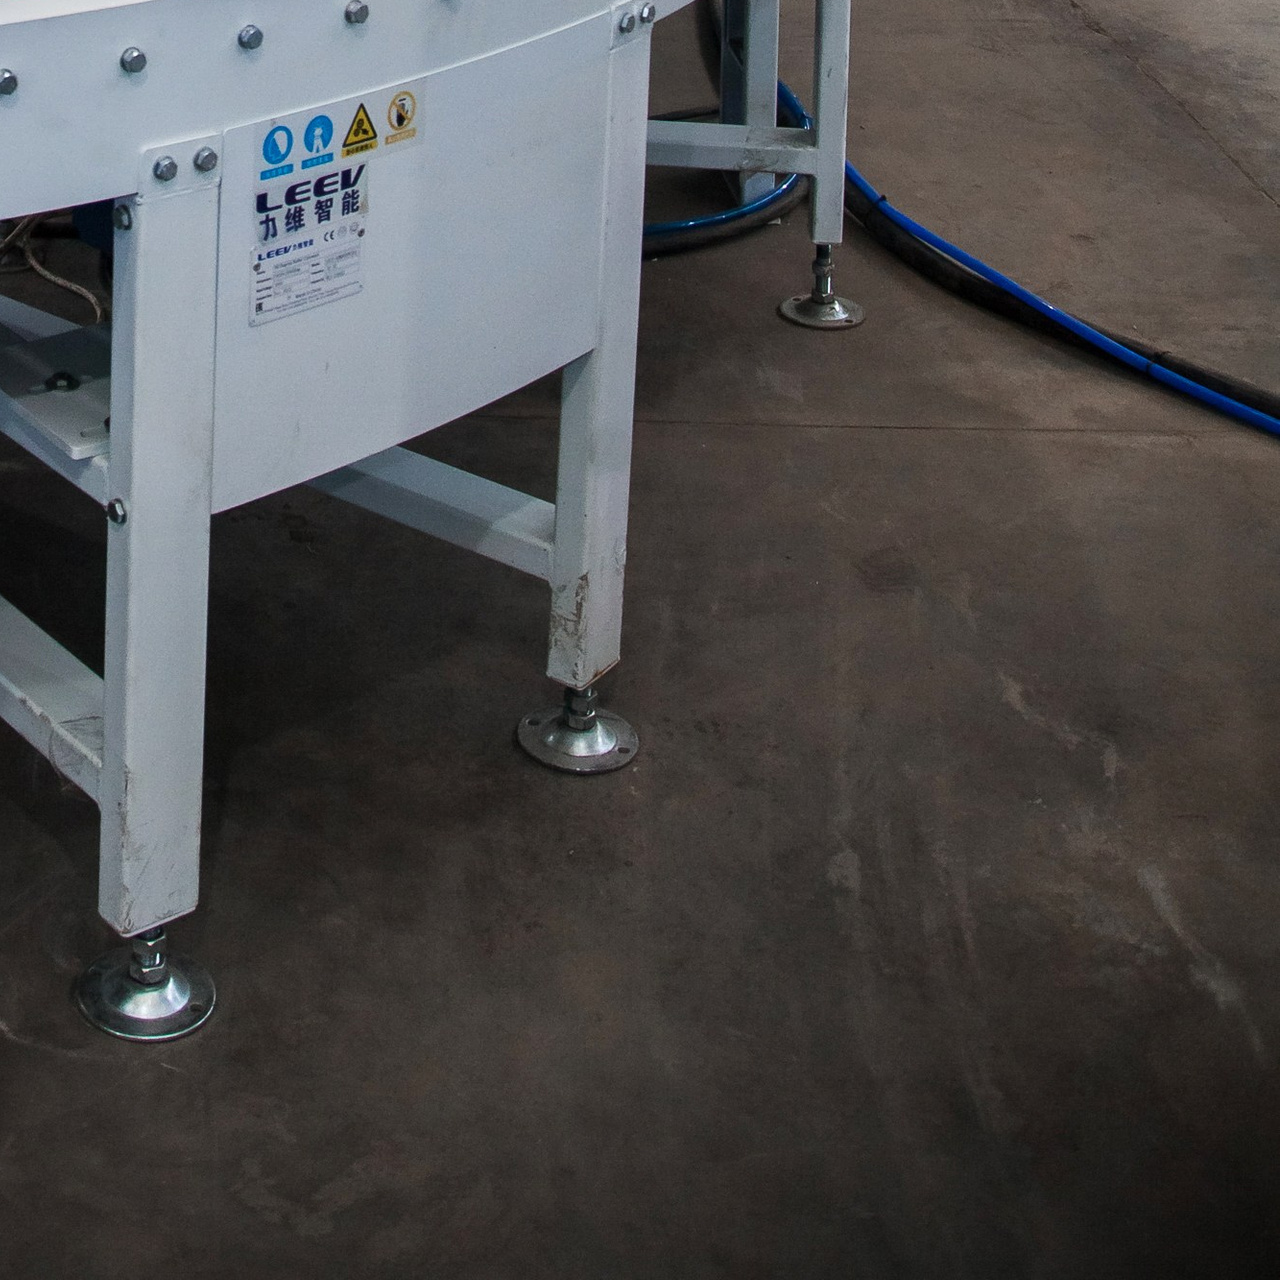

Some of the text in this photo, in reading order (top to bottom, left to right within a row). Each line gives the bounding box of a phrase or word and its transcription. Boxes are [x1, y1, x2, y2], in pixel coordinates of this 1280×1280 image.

[256, 164, 365, 214] LEEV
[259, 189, 361, 241] 力维智能
[257, 244, 292, 262] LEEV
